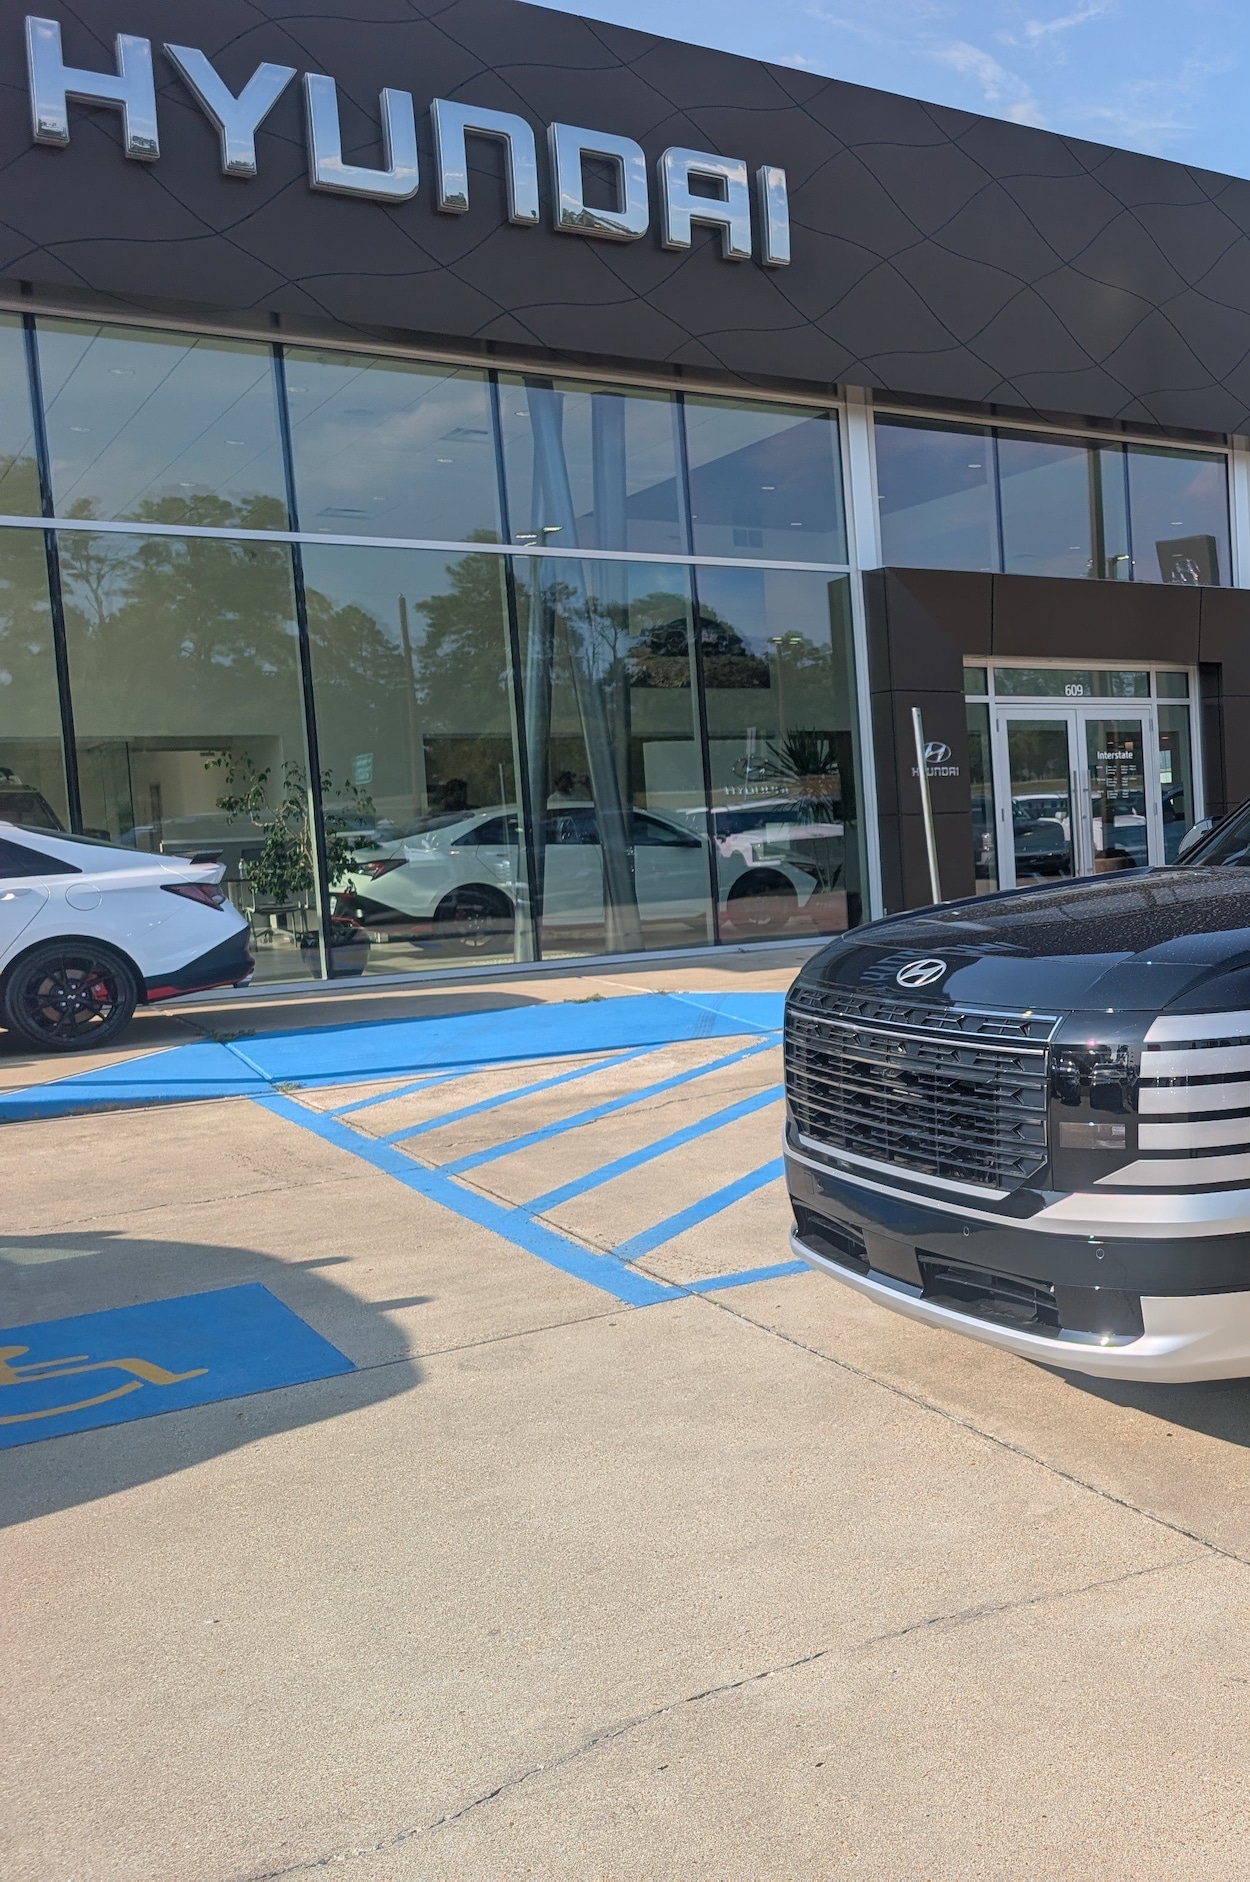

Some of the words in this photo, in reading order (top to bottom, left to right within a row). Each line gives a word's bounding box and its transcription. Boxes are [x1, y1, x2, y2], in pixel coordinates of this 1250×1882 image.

[25, 15, 791, 267] HYUNDAI
[1065, 684, 1084, 696] 609
[1096, 750, 1134, 760] Interstate
[911, 766, 960, 777] HUNDAI
